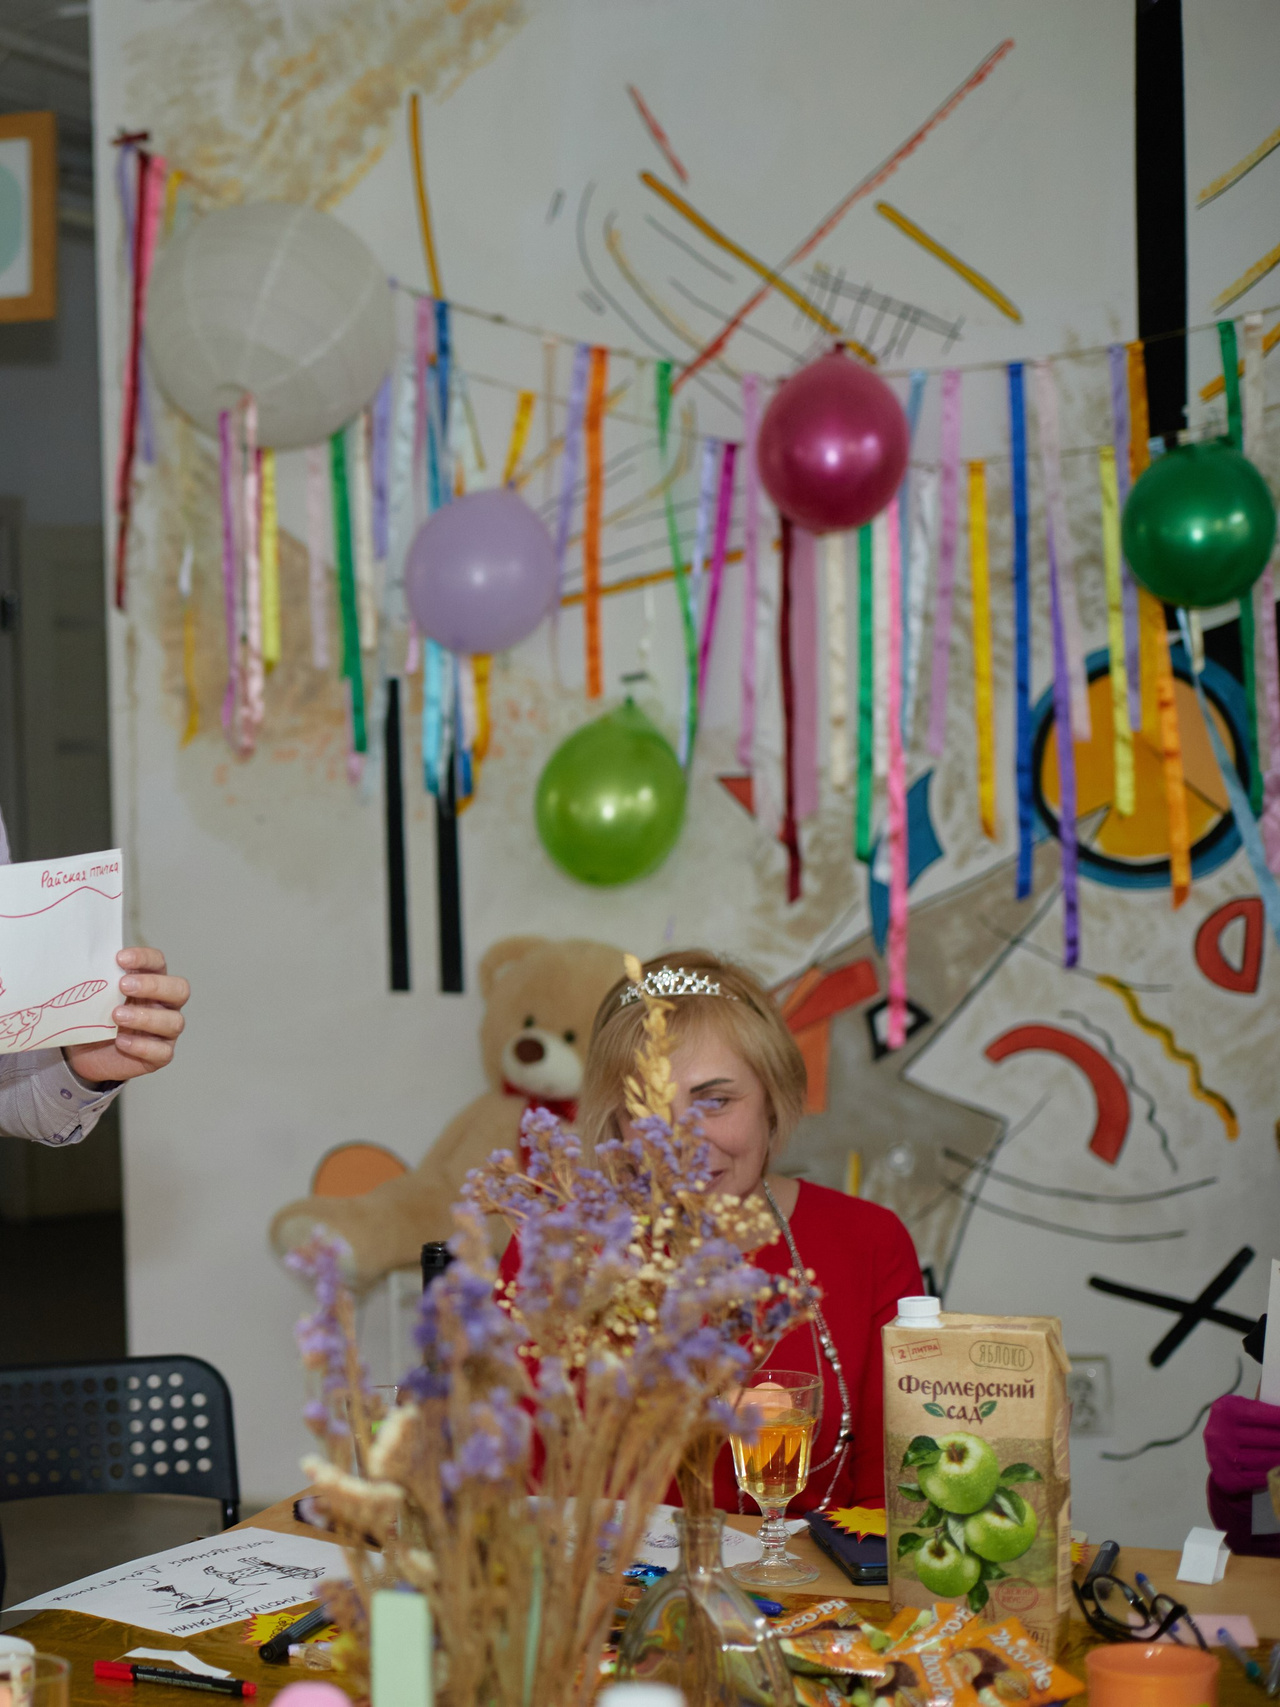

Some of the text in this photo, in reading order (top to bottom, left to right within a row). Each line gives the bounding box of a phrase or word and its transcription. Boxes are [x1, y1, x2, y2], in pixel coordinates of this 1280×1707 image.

[40, 861, 119, 888] Райская птичка
[897, 1343, 939, 1359] 2 ЛИТРА
[978, 1344, 1026, 1368] ЯБЛОКО
[897, 1374, 1035, 1403] Фермерский
